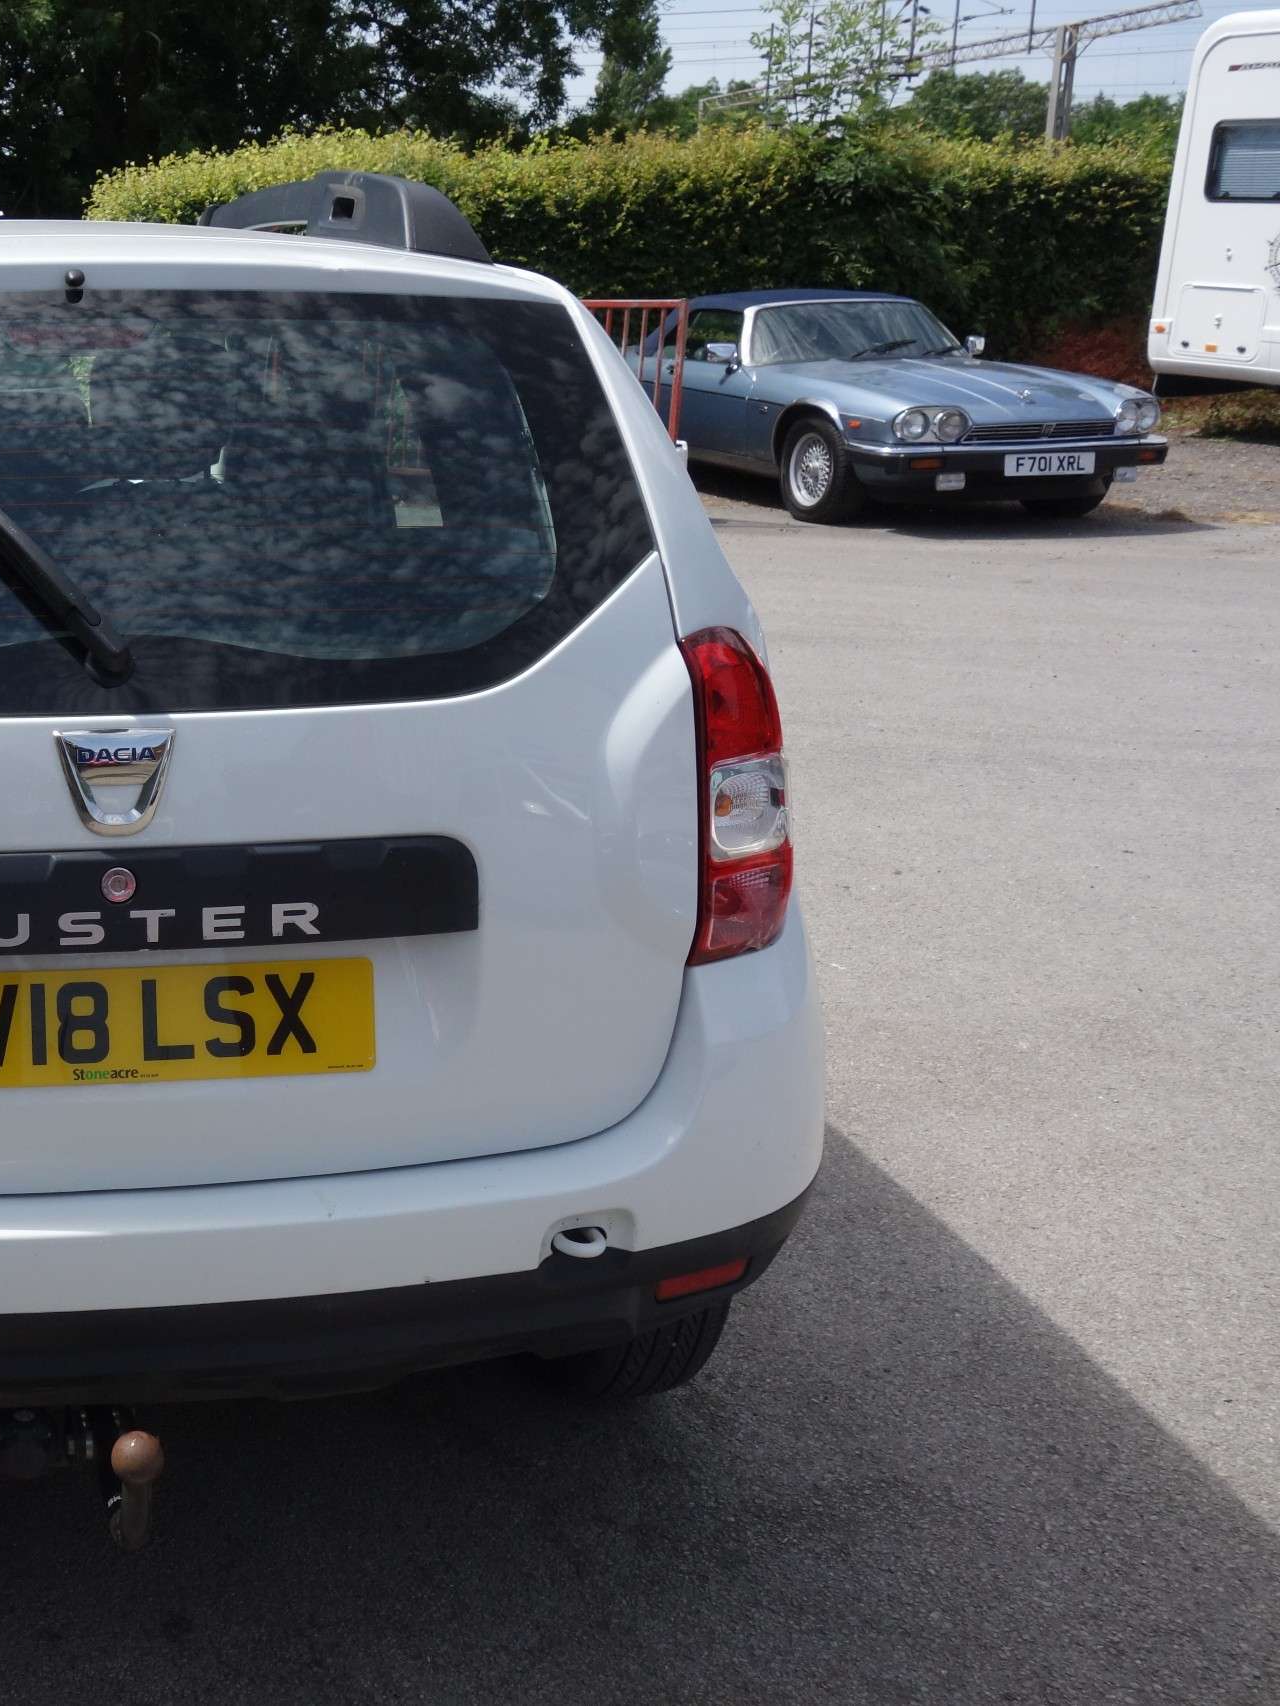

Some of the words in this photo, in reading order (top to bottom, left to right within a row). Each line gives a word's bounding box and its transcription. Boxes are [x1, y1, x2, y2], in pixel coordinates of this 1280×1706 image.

[1015, 456, 1052, 473] F701
[1057, 455, 1085, 472] XRL
[76, 747, 157, 763] DACIA
[141, 972, 317, 1062] LSX
[72, 1068, 139, 1081] Stoneacre
